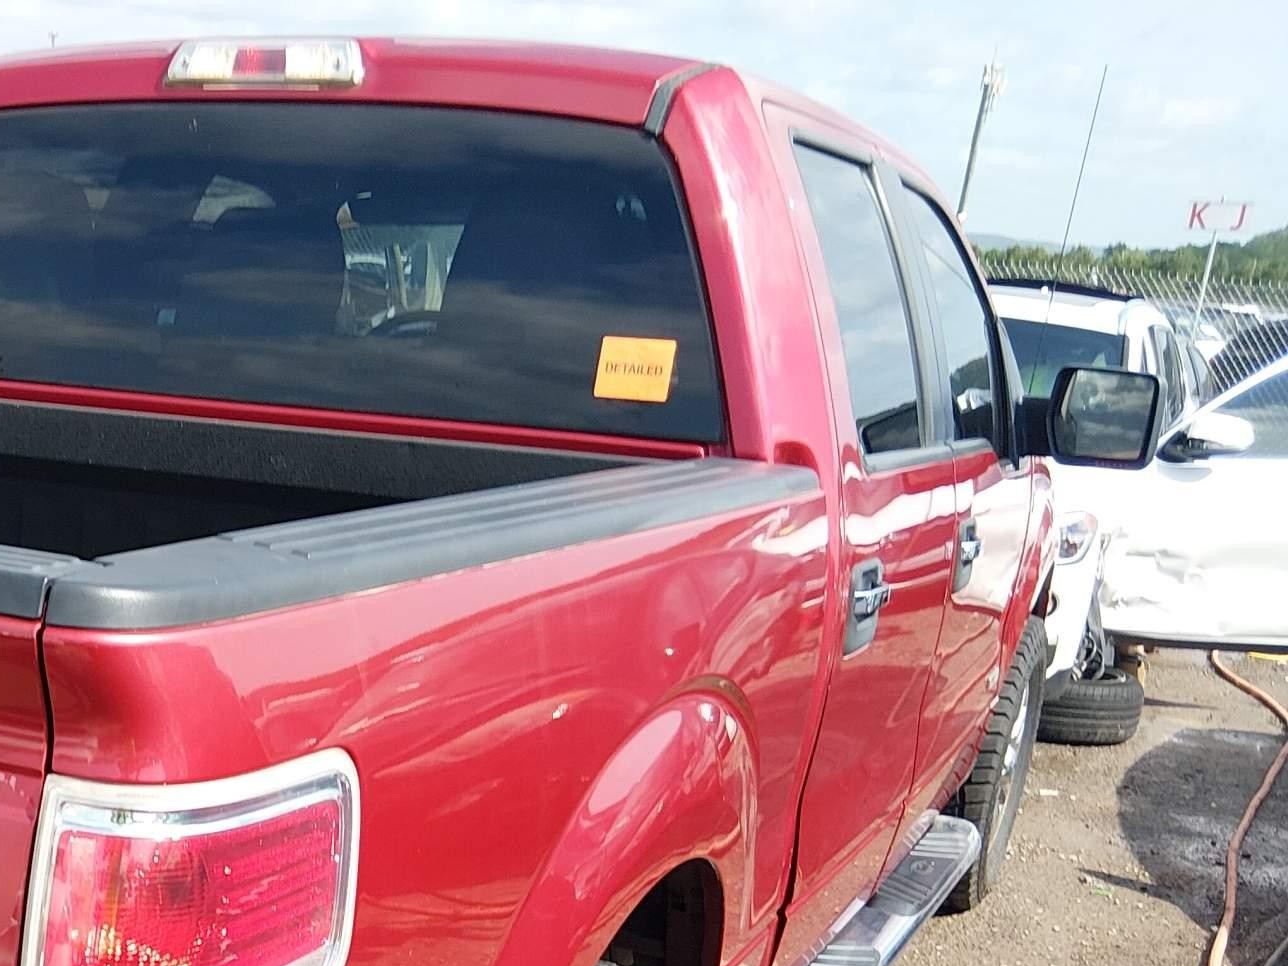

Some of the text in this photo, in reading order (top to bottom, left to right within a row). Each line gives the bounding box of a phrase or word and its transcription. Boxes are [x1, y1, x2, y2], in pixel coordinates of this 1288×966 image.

[1188, 202, 1247, 231] K J
[604, 361, 664, 376] DETAILED
